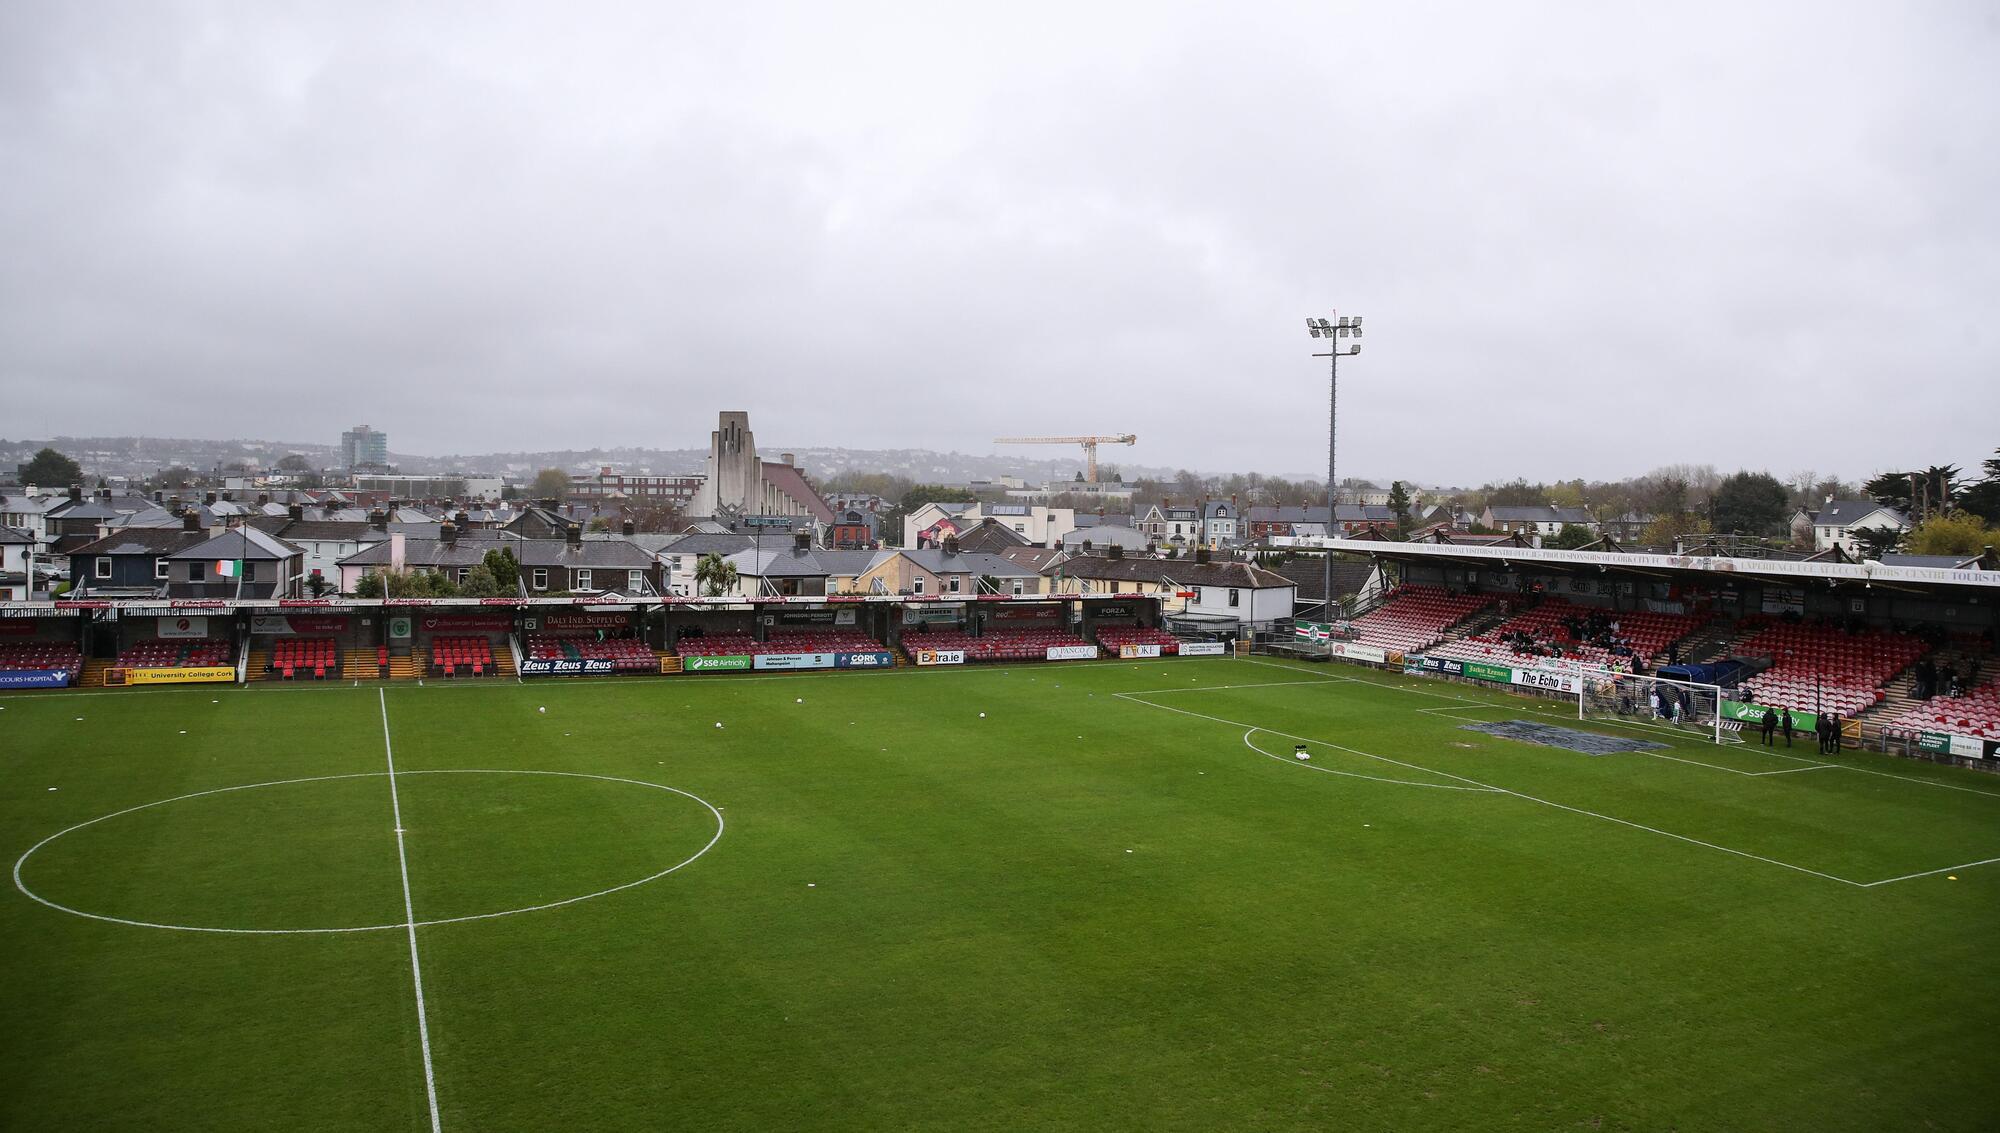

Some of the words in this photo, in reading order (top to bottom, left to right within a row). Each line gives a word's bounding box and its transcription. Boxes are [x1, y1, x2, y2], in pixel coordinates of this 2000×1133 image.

[547, 616, 566, 624] DALY
[586, 615, 612, 624] SUPPLY
[851, 654, 876, 662] CORK
[922, 653, 960, 662] Extra.ie
[523, 661, 551, 671] Zeus
[554, 660, 582, 670] Zeus
[584, 659, 612, 670] Zeus
[703, 659, 719, 667] sse
[719, 659, 746, 668] Airtricity
[1423, 658, 1439, 667] Zeus
[1443, 660, 1462, 671] Zeus
[188, 671, 215, 679] College
[1522, 671, 1537, 685] The
[1538, 674, 1559, 688] Echo
